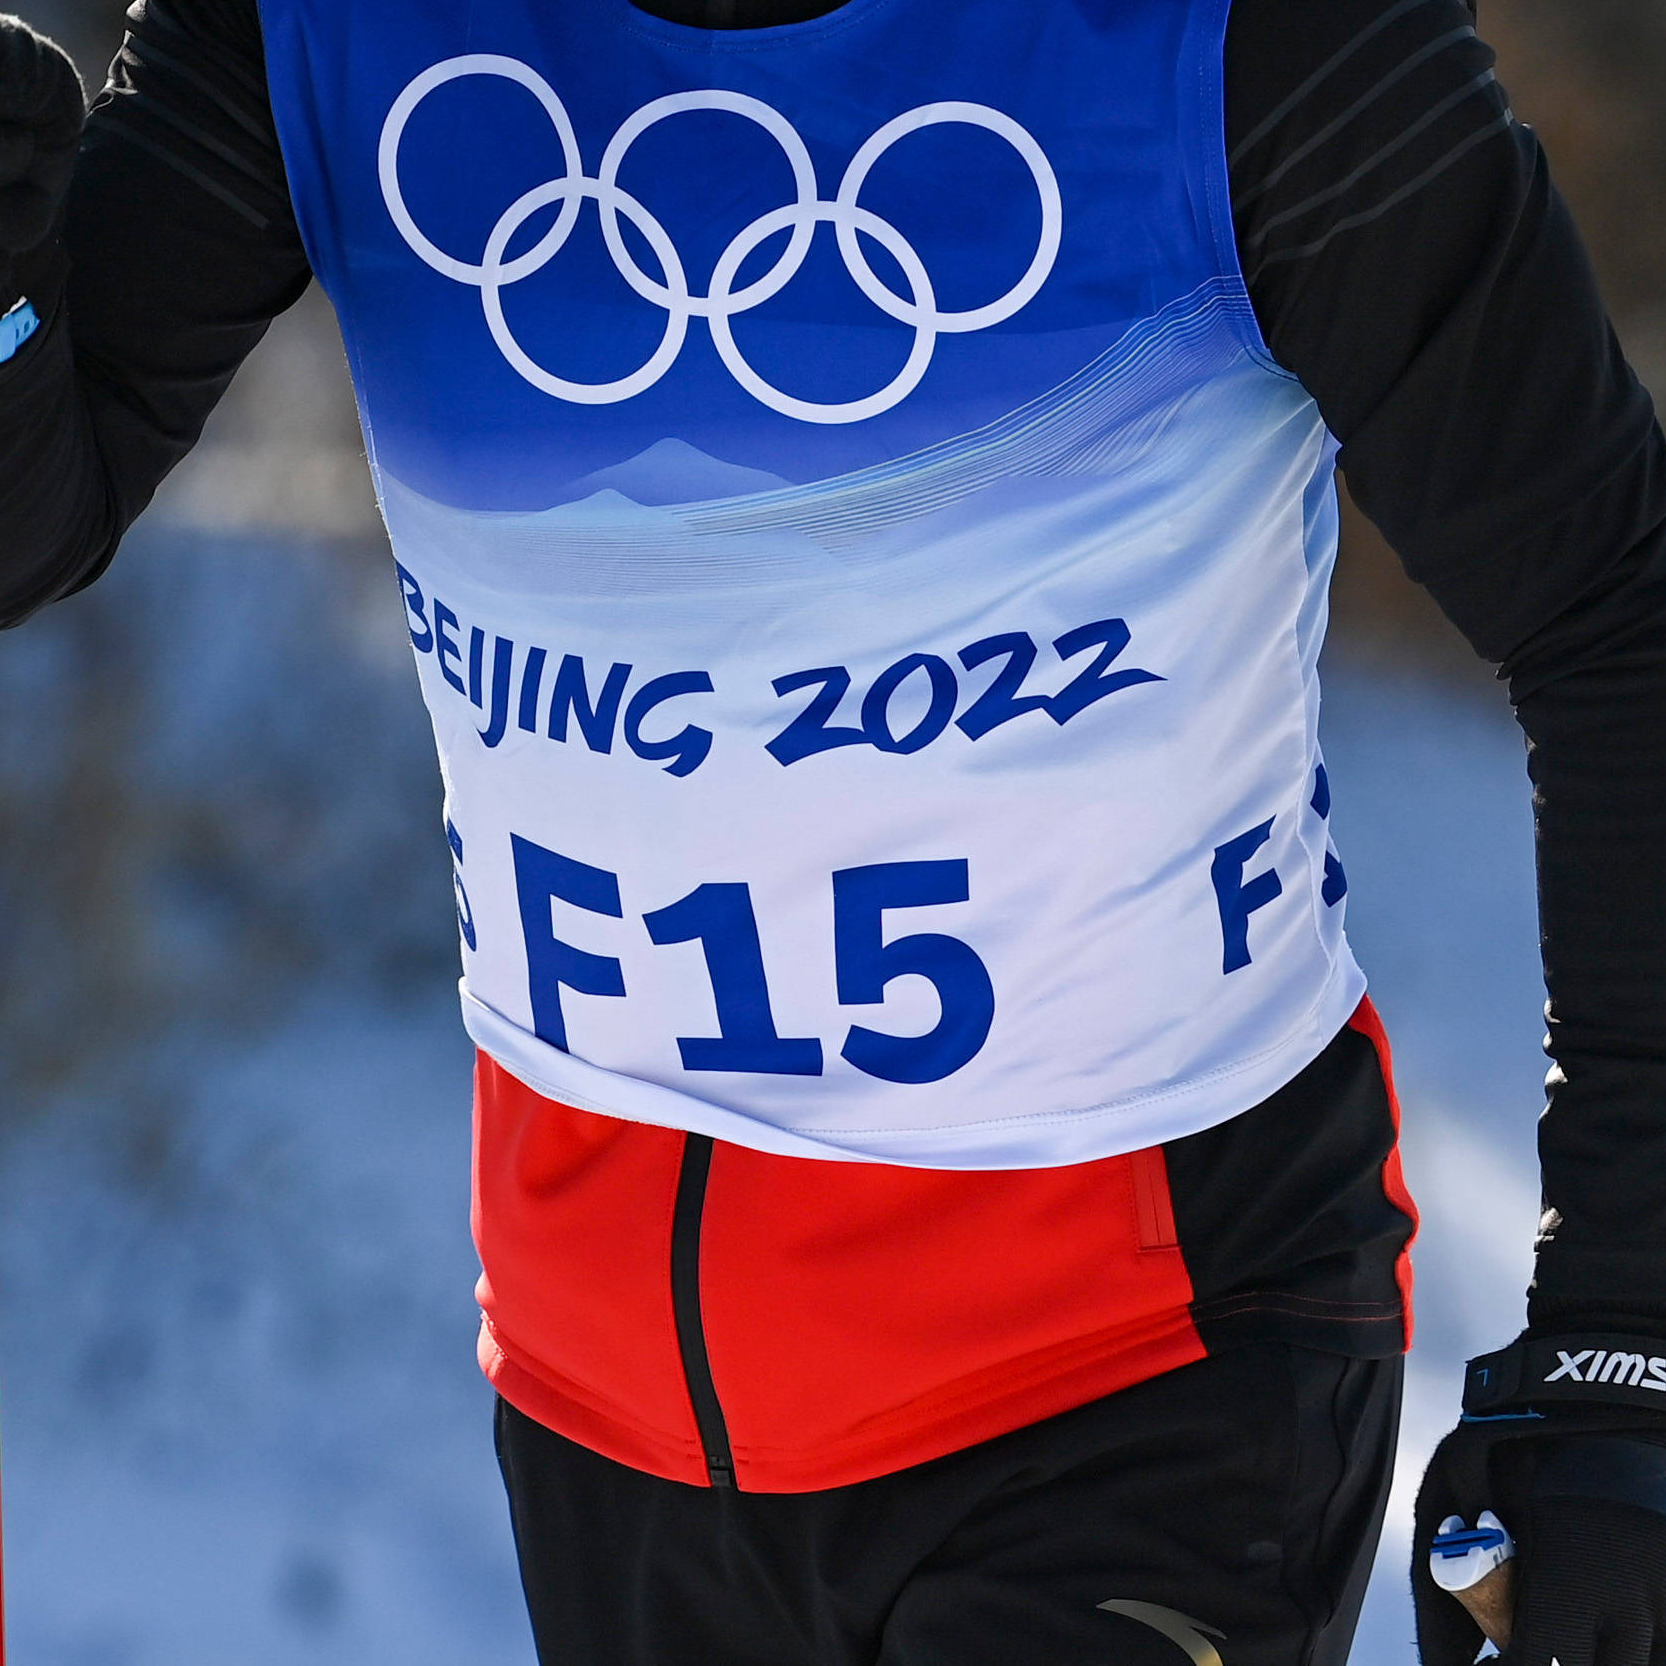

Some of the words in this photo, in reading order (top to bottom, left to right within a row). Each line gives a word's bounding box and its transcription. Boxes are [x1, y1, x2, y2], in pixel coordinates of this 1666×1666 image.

[396, 560, 714, 777] BEIJING
[764, 618, 1165, 767] 2022
[509, 831, 995, 1084] F15
